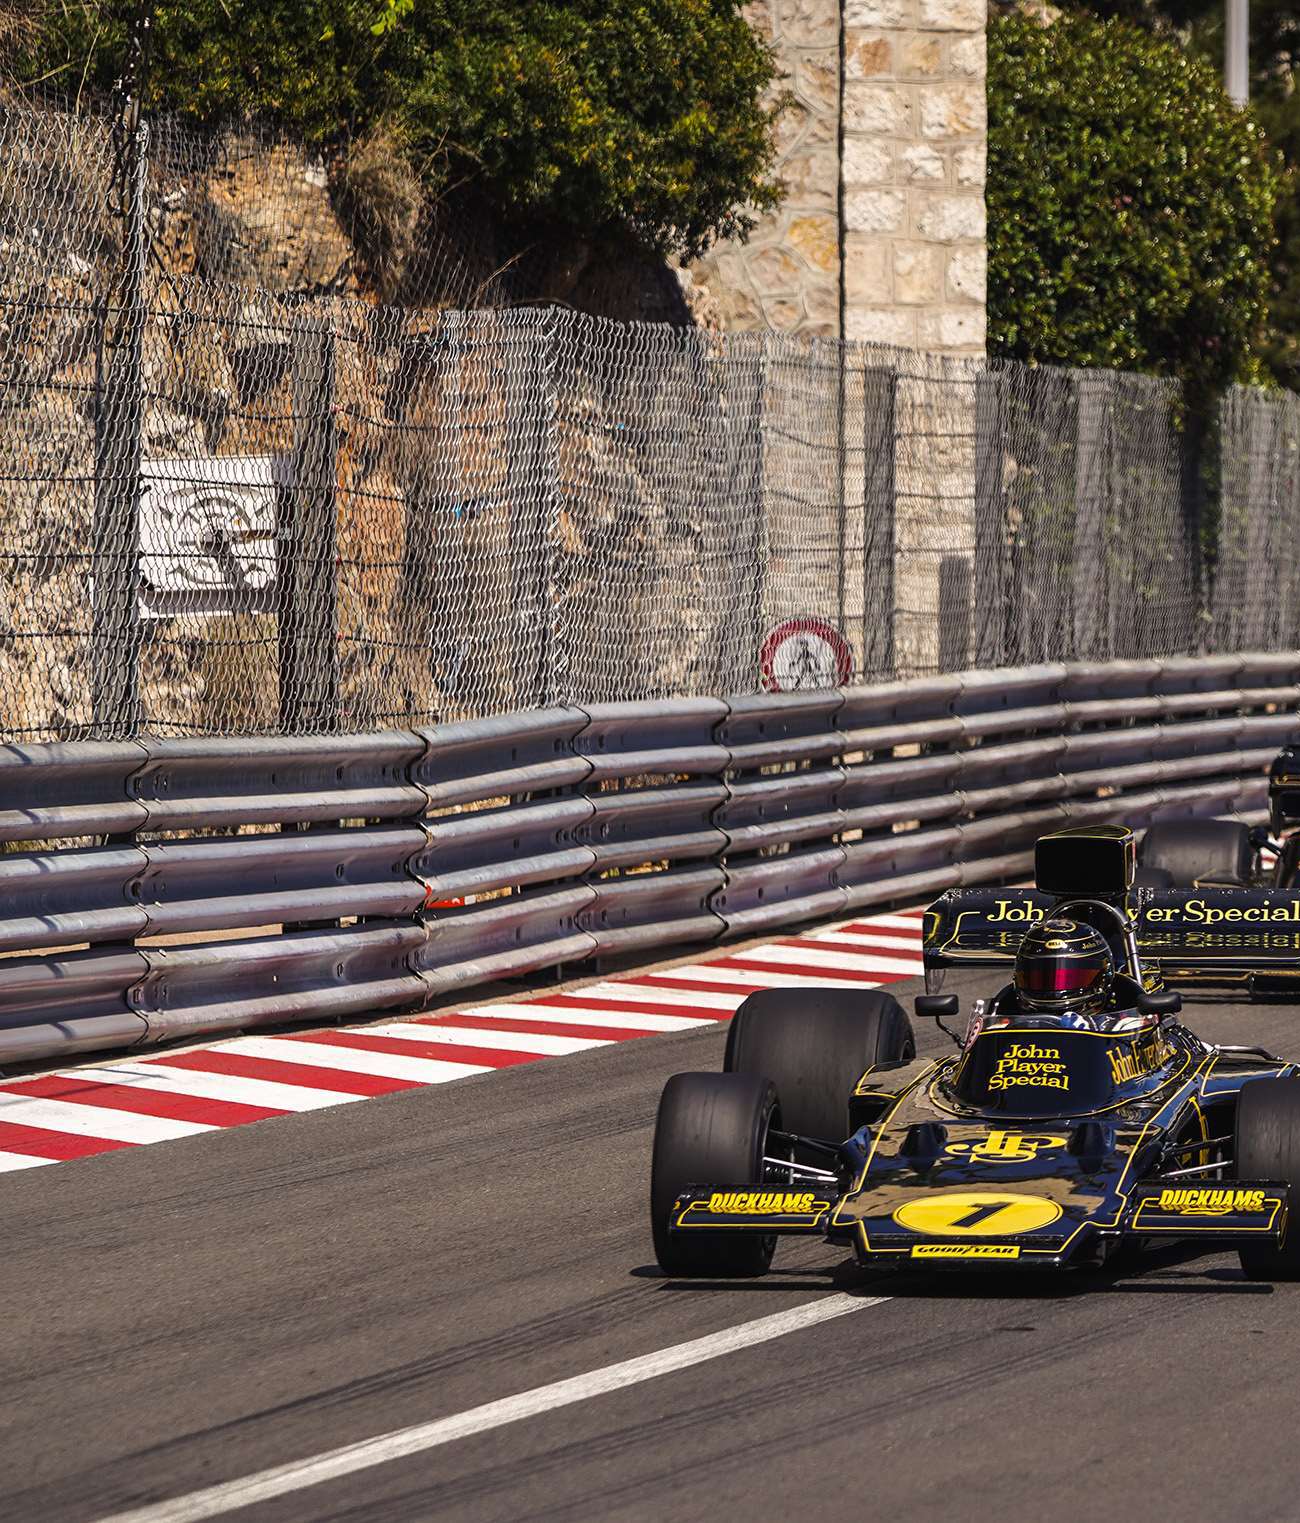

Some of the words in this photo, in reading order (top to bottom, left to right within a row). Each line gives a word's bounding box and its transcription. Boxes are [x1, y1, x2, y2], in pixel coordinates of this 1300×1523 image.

[986, 900, 1045, 921] Joh
[1004, 1045, 1060, 1059] John
[997, 1059, 1067, 1075] Player
[1106, 1046, 1136, 1085] John
[988, 1074, 1070, 1091] Special
[707, 1193, 816, 1208] DUCKHAMS
[1158, 1190, 1265, 1206] DUCKHAMS
[950, 1201, 1013, 1228] 1
